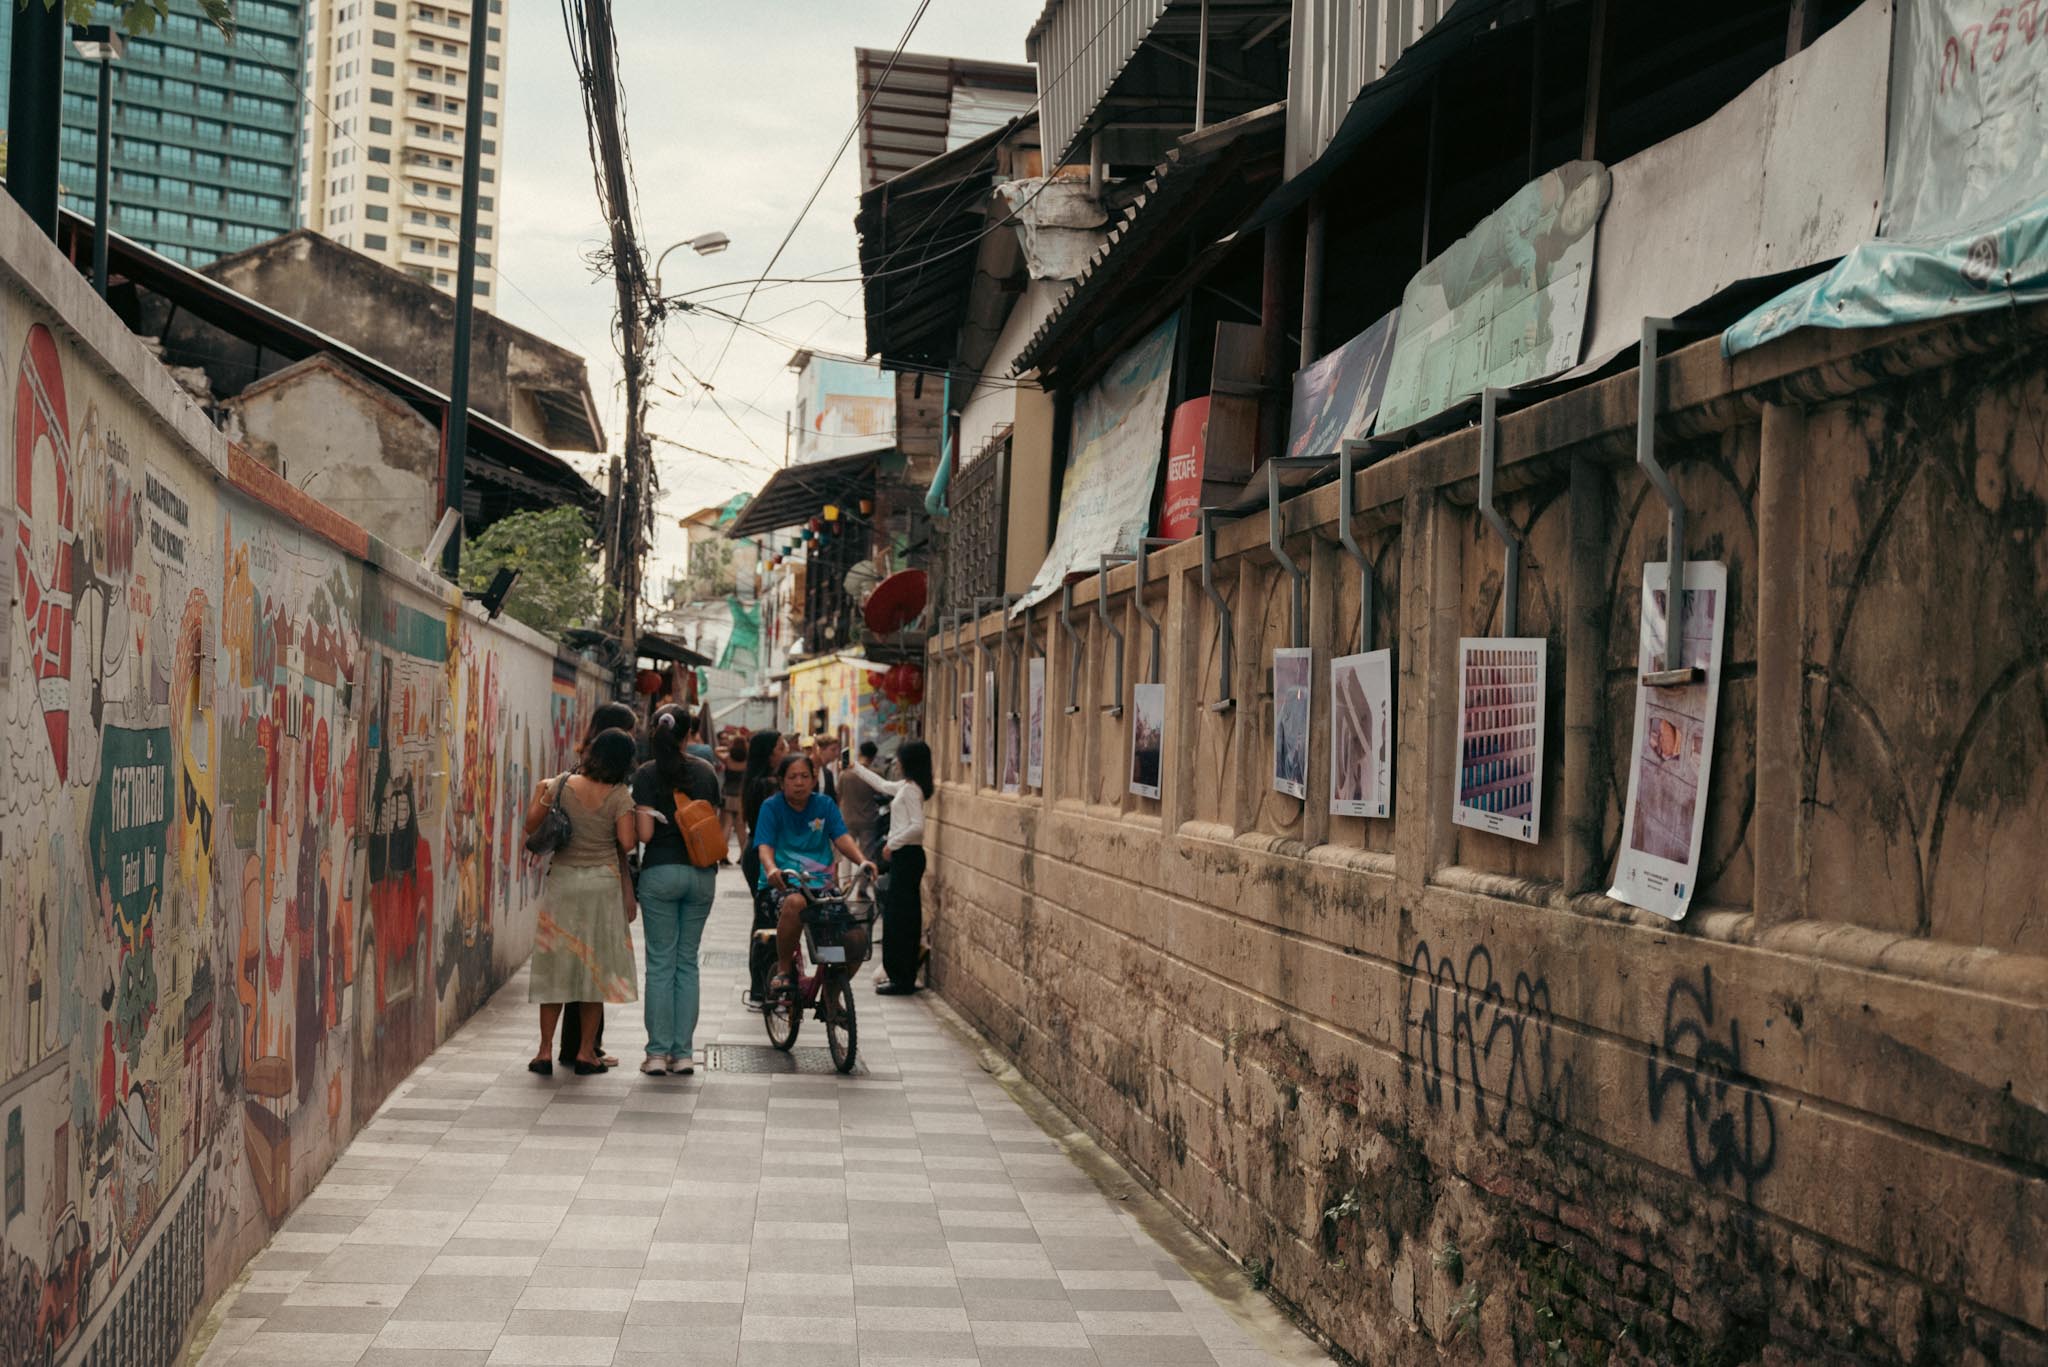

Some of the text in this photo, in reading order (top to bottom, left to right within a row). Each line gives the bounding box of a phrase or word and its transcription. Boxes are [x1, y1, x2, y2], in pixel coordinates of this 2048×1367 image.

[112, 738, 165, 833] ตลาดน้อย
[121, 846, 157, 897] Talat Noi
